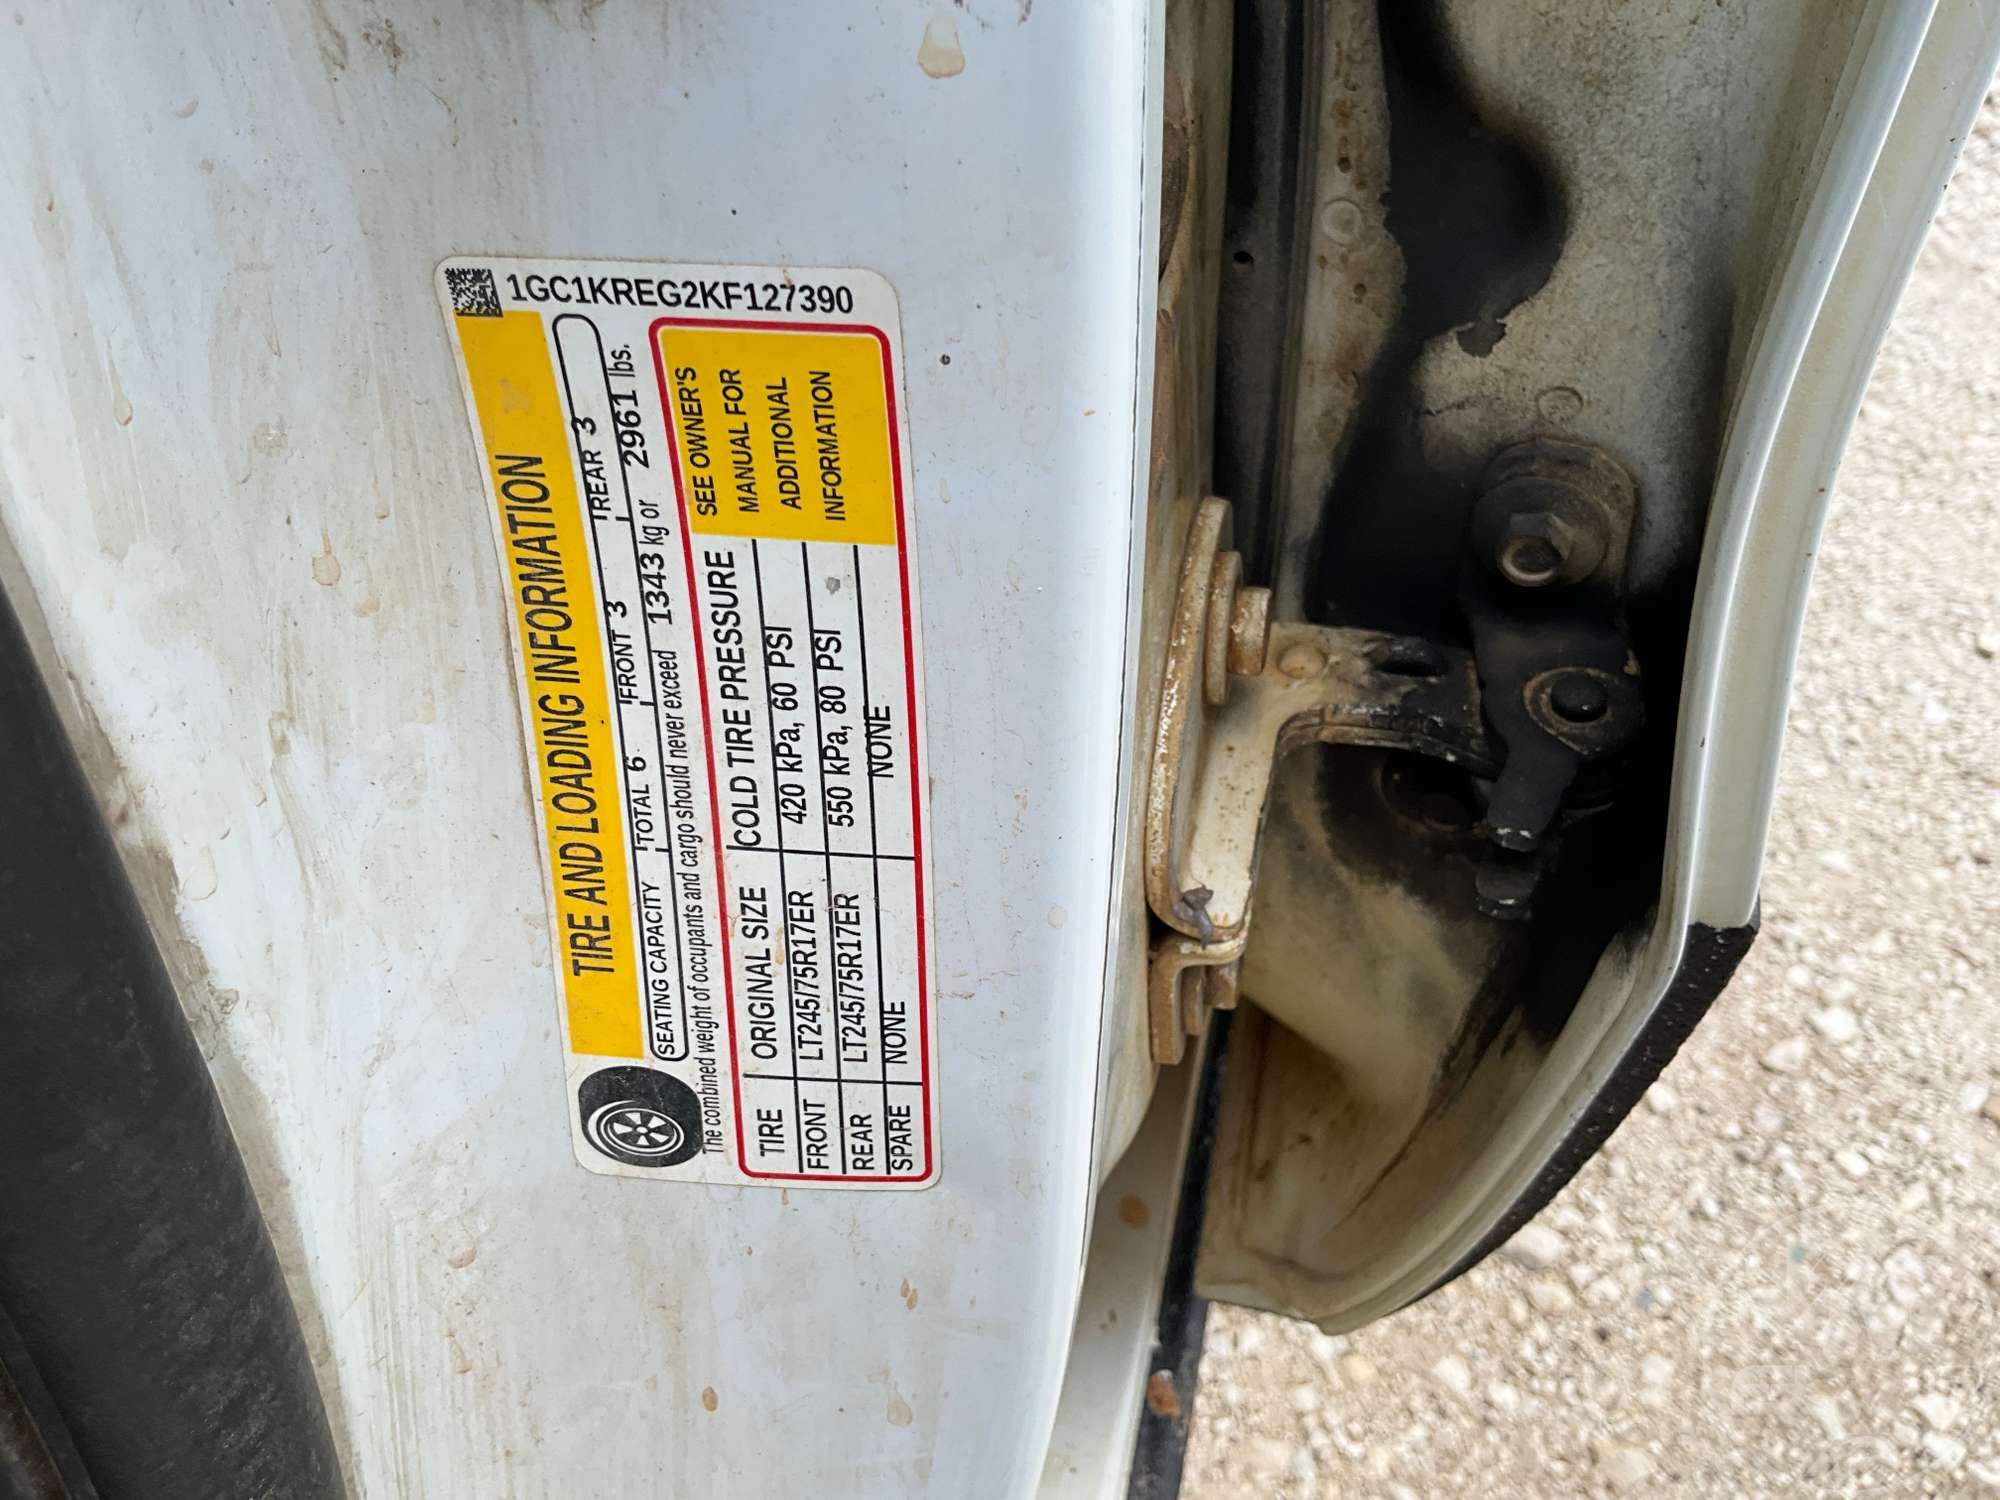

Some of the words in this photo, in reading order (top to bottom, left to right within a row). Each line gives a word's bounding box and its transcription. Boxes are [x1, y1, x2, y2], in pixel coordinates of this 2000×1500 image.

[506, 274, 853, 313] 1GC1KREG2KF127390
[607, 343, 637, 378] lbs.
[675, 366, 710, 470] OWNER'S
[720, 368, 747, 416] FOR
[573, 416, 596, 435] 3
[614, 389, 649, 469] 2961
[766, 376, 802, 509] ADDITIONAL
[809, 370, 845, 521] INFORMATION
[582, 451, 608, 514] REAR
[689, 475, 718, 517] SEE
[728, 421, 759, 513] MANUAL
[639, 519, 670, 547] kg
[640, 499, 660, 517] or
[498, 454, 581, 687] INFORMATION
[644, 553, 673, 624] 1343
[606, 601, 627, 618] 3
[704, 551, 750, 707] PRESSURE
[612, 630, 639, 701] FRONT
[764, 626, 795, 668] PSI
[814, 630, 843, 672] PSI
[654, 650, 682, 709] exceed
[770, 682, 798, 711] 60
[819, 685, 846, 714] 80
[538, 694, 601, 834] LOADING
[625, 756, 646, 772] 6
[662, 714, 690, 760] never
[722, 709, 754, 768] TIRE
[774, 722, 805, 774] kPa,
[822, 725, 852, 776] kPa,
[867, 705, 894, 778] NONE
[633, 783, 654, 845] TOTAL
[669, 765, 693, 822] should
[730, 775, 761, 848] COLD
[778, 783, 806, 825] 420
[826, 786, 854, 827] 550
[557, 843, 608, 906] AND
[674, 823, 702, 874] cargo
[676, 873, 700, 901] and
[739, 886, 770, 941] SIZE
[566, 913, 615, 977] TIRE
[645, 881, 670, 973] CAPACITY
[684, 903, 712, 983] occupants
[691, 985, 710, 1003] of
[743, 947, 777, 1060] ORIGINAL
[787, 889, 824, 1061] LT245/75R17ER
[834, 892, 869, 1063] LT245/75R17ER
[650, 975, 673, 1056] SEATING
[690, 1007, 719, 1055] weight
[882, 1001, 908, 1065] NONE
[697, 1056, 721, 1126] combined
[702, 1128, 724, 1154] The
[756, 1108, 784, 1157] TIRE
[802, 1098, 830, 1171] FRONT
[852, 1113, 875, 1171] REAR
[889, 1104, 913, 1171] SPARE
